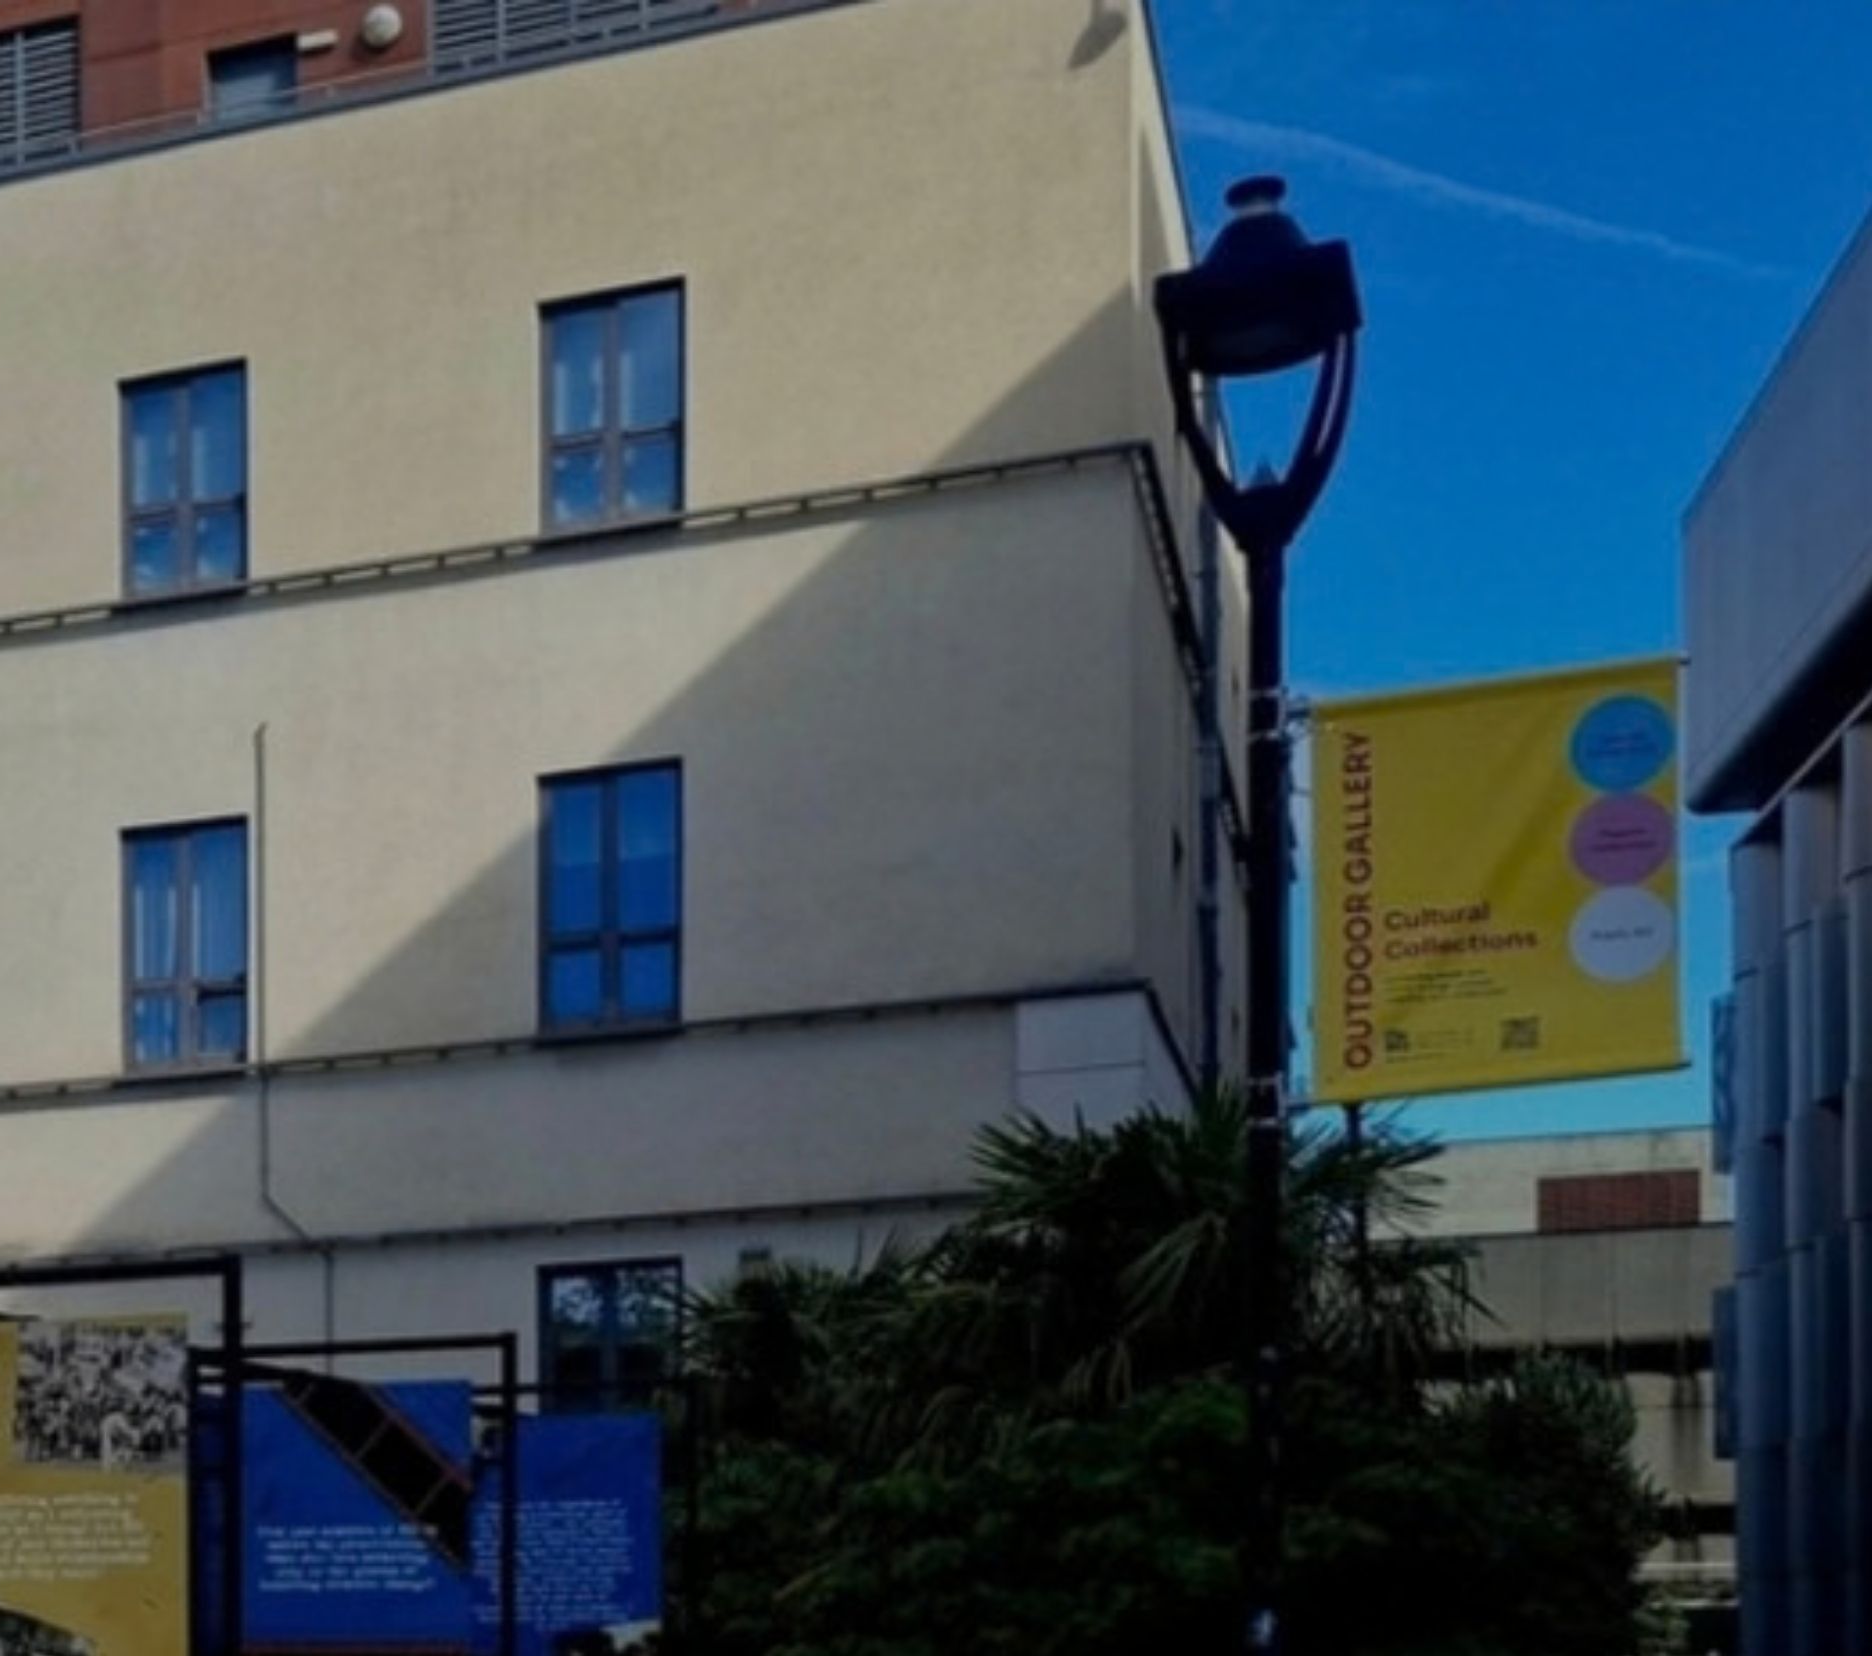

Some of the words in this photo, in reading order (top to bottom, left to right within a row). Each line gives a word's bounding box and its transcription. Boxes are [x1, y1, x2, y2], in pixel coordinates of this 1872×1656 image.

[1342, 731, 1373, 884] GALLERY
[1384, 901, 1491, 932] Cultural
[1384, 929, 1538, 961] Collections
[1343, 894, 1373, 1069] OUTDOOR
